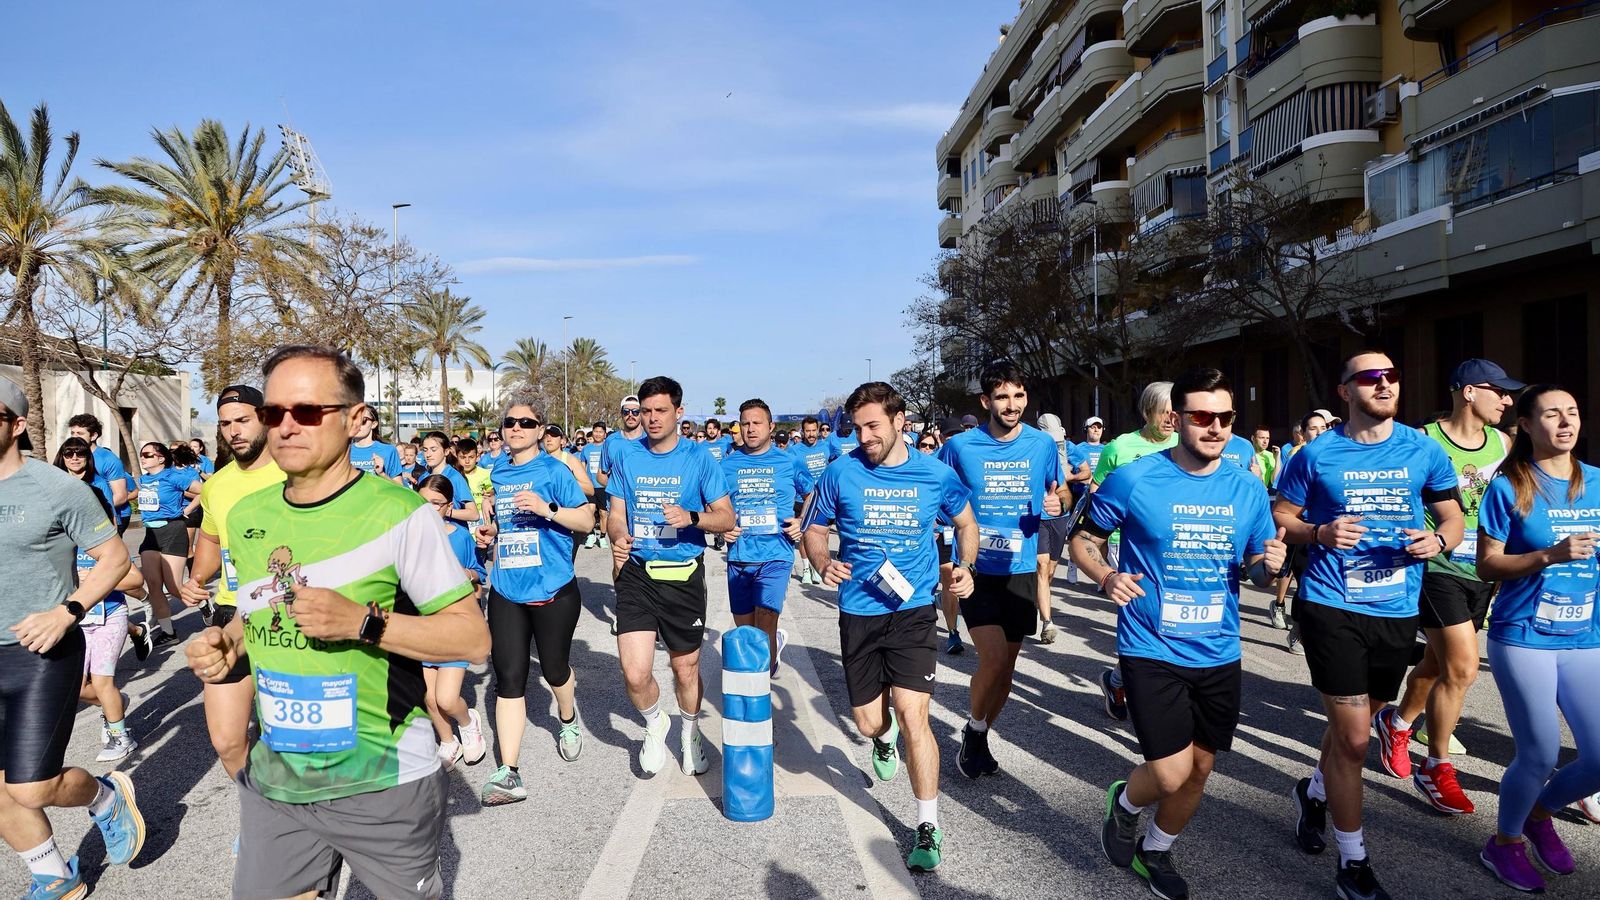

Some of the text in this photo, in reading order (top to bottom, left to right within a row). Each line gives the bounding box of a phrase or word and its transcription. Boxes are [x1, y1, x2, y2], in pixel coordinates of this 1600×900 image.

[738, 466, 774, 475] mayoral
[984, 459, 1030, 471] mayoral
[636, 475, 681, 487] mayoral
[1343, 466, 1409, 483] mayoral
[498, 481, 533, 493] mayoral
[864, 486, 918, 500] mayoral
[1173, 504, 1234, 518] mayoral
[1547, 508, 1600, 520] mayor
[749, 515, 767, 525] 583
[643, 525, 665, 537] 317
[505, 543, 530, 556] 1445
[989, 536, 1011, 550] 702
[1364, 568, 1393, 584] 809
[1180, 605, 1209, 620] 810
[1558, 605, 1584, 619] 199
[322, 677, 353, 688] mayoral
[274, 699, 324, 725] 388
